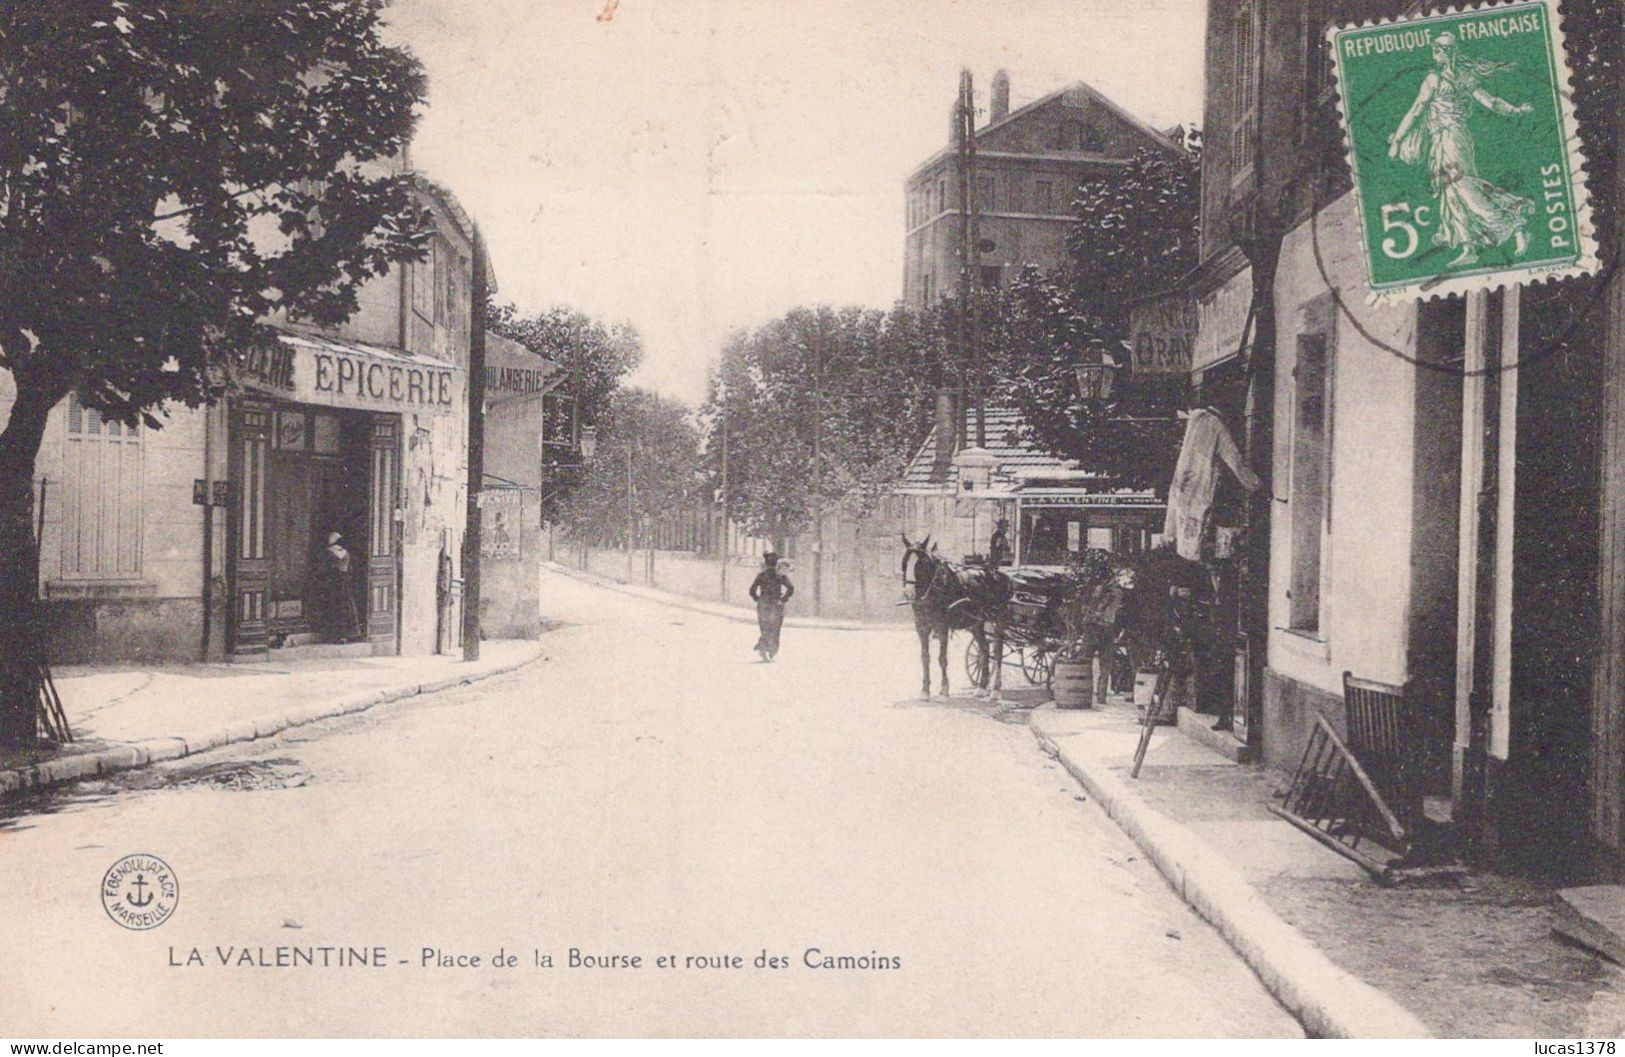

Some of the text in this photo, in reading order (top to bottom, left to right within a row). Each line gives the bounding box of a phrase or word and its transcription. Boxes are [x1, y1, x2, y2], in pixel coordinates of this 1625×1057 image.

[1458, 13, 1541, 41] FRANÇAISE
[1540, 163, 1570, 249] POSTES
[314, 353, 452, 405] EPICERIE
[110, 902, 171, 926] MARSEILLE
[170, 947, 204, 966] LA
[216, 947, 386, 966] VALENTINE
[422, 948, 480, 967] Place
[492, 948, 517, 967] de
[535, 949, 553, 967] la
[569, 948, 641, 968] Bourse
[657, 955, 675, 968] et
[687, 956, 742, 968] route
[754, 950, 788, 969] des
[804, 948, 900, 969] Camoins
